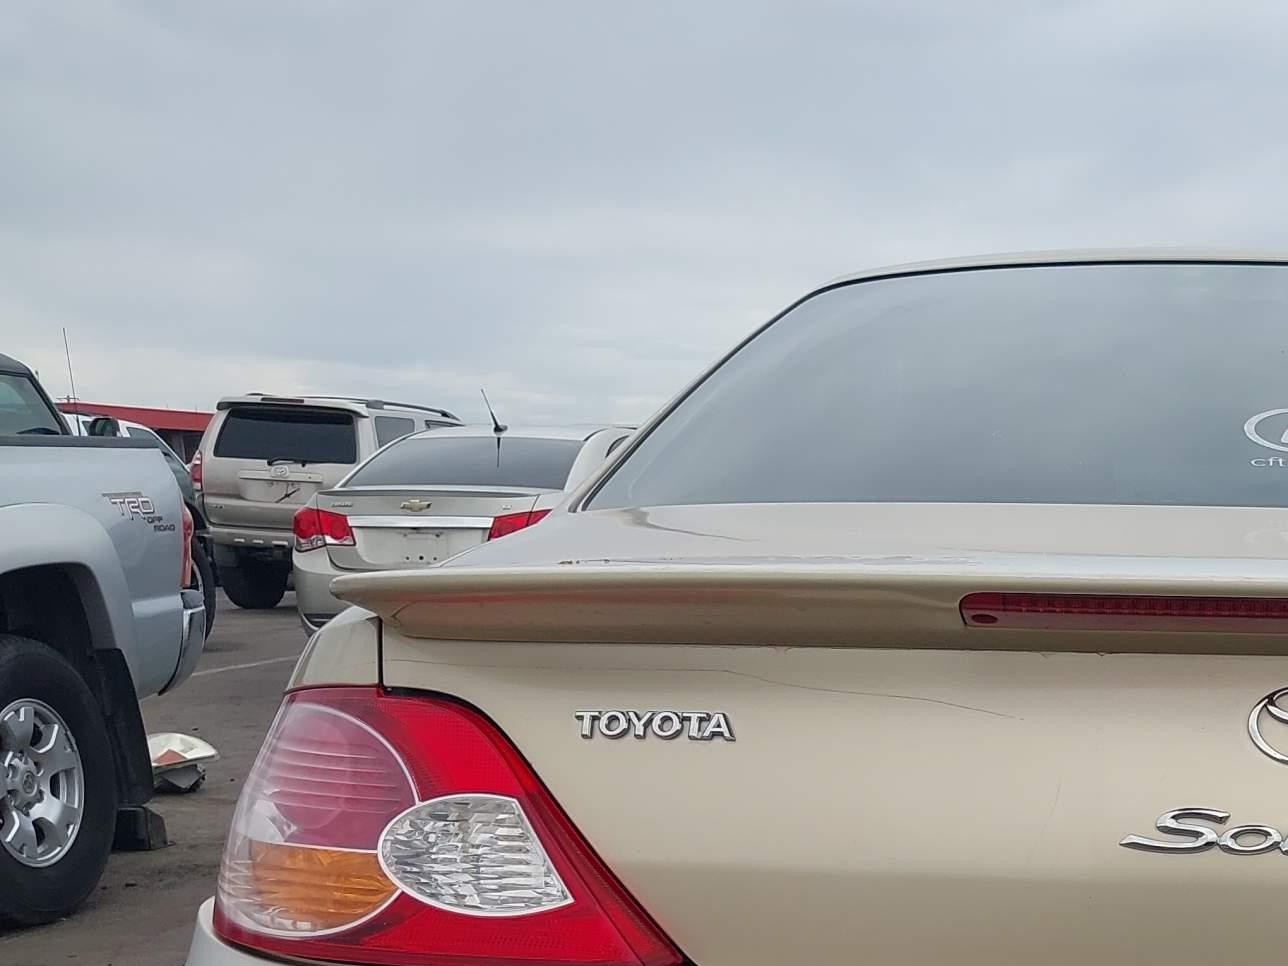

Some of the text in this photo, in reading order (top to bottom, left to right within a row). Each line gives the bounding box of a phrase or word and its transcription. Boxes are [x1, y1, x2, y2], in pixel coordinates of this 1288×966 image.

[110, 497, 155, 520] TRD
[146, 516, 163, 524] OFF
[575, 711, 736, 741] TOYOTA
